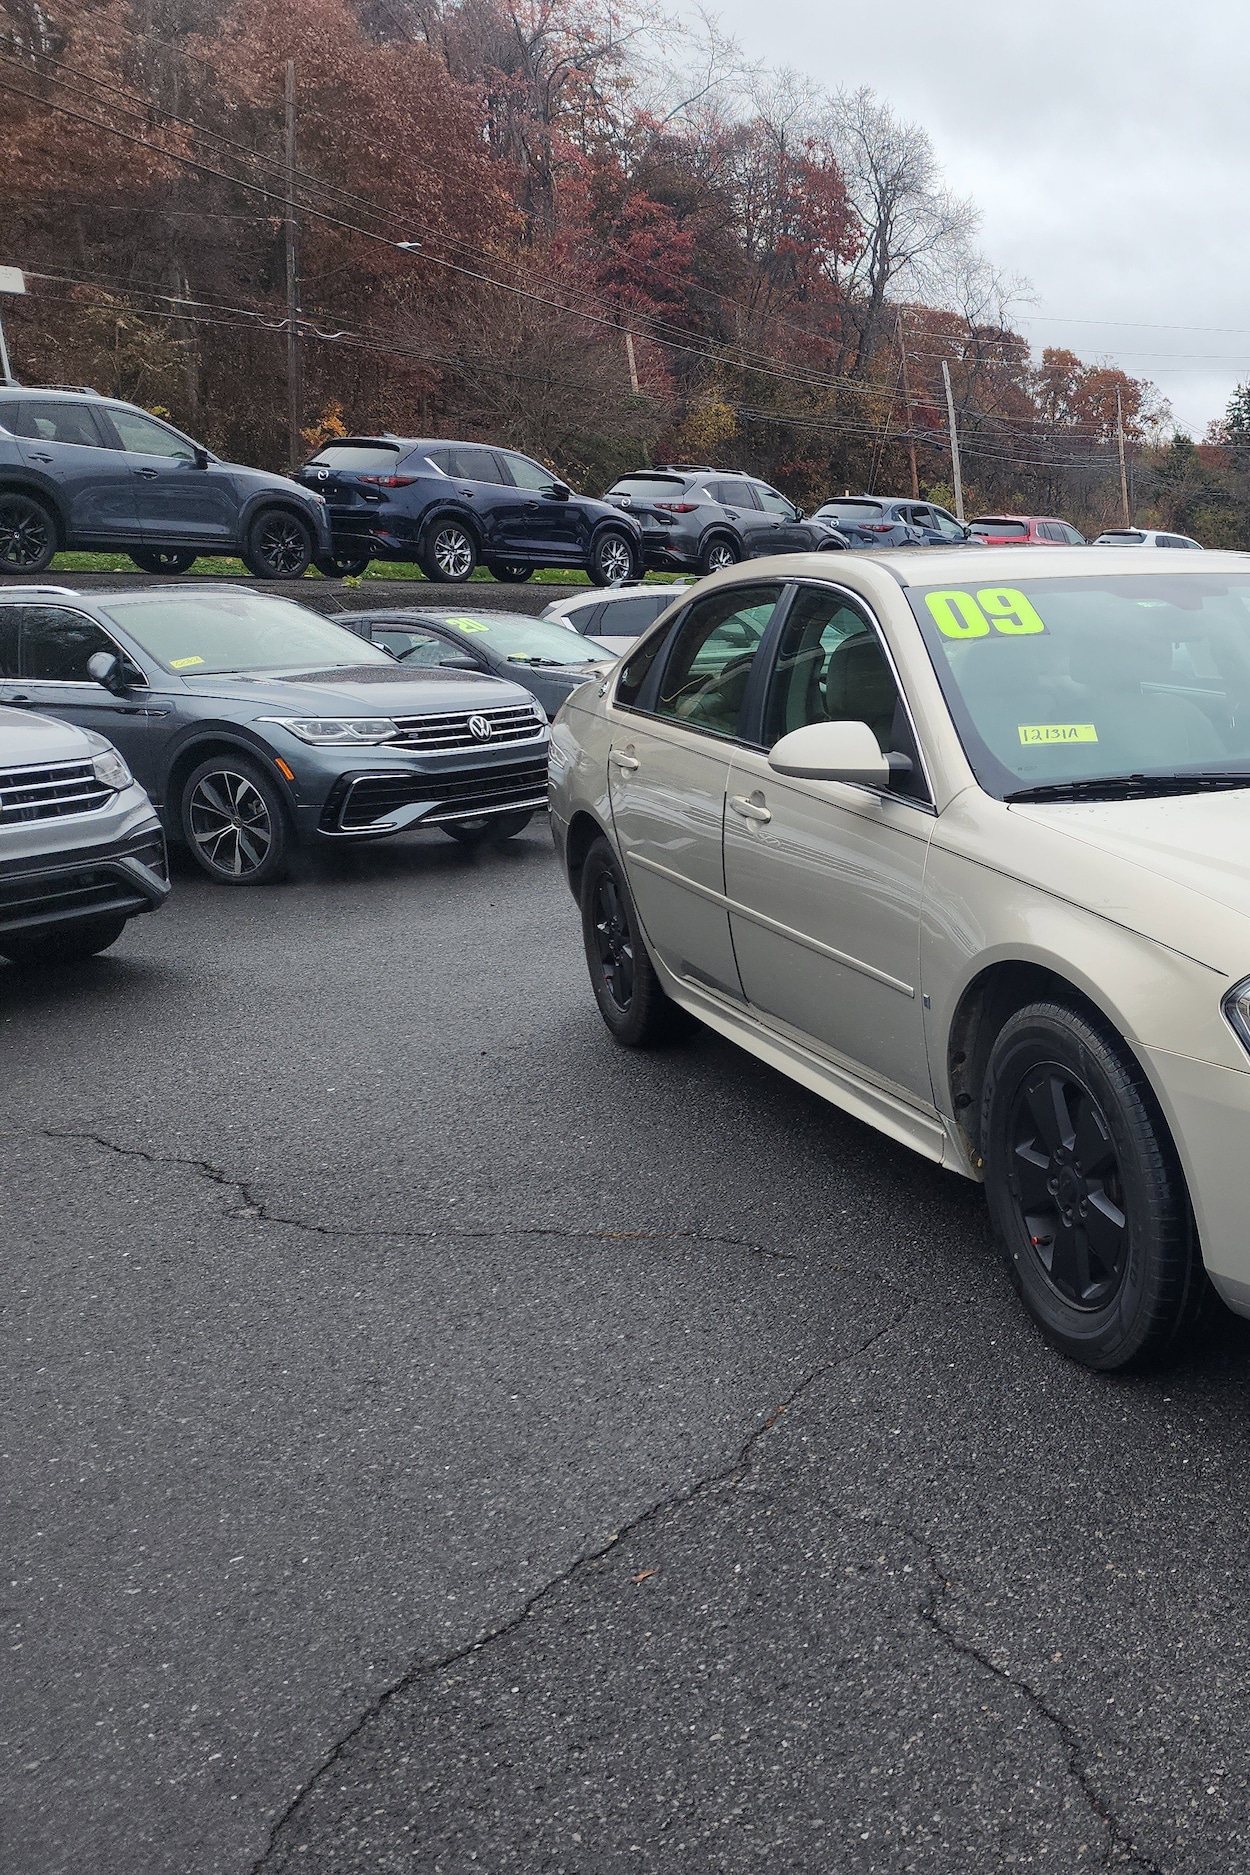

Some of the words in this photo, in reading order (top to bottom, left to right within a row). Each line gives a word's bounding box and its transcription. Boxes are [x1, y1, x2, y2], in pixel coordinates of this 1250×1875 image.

[925, 588, 1045, 638] 09
[446, 618, 490, 633] 20
[1024, 728, 1078, 741] 12131A
